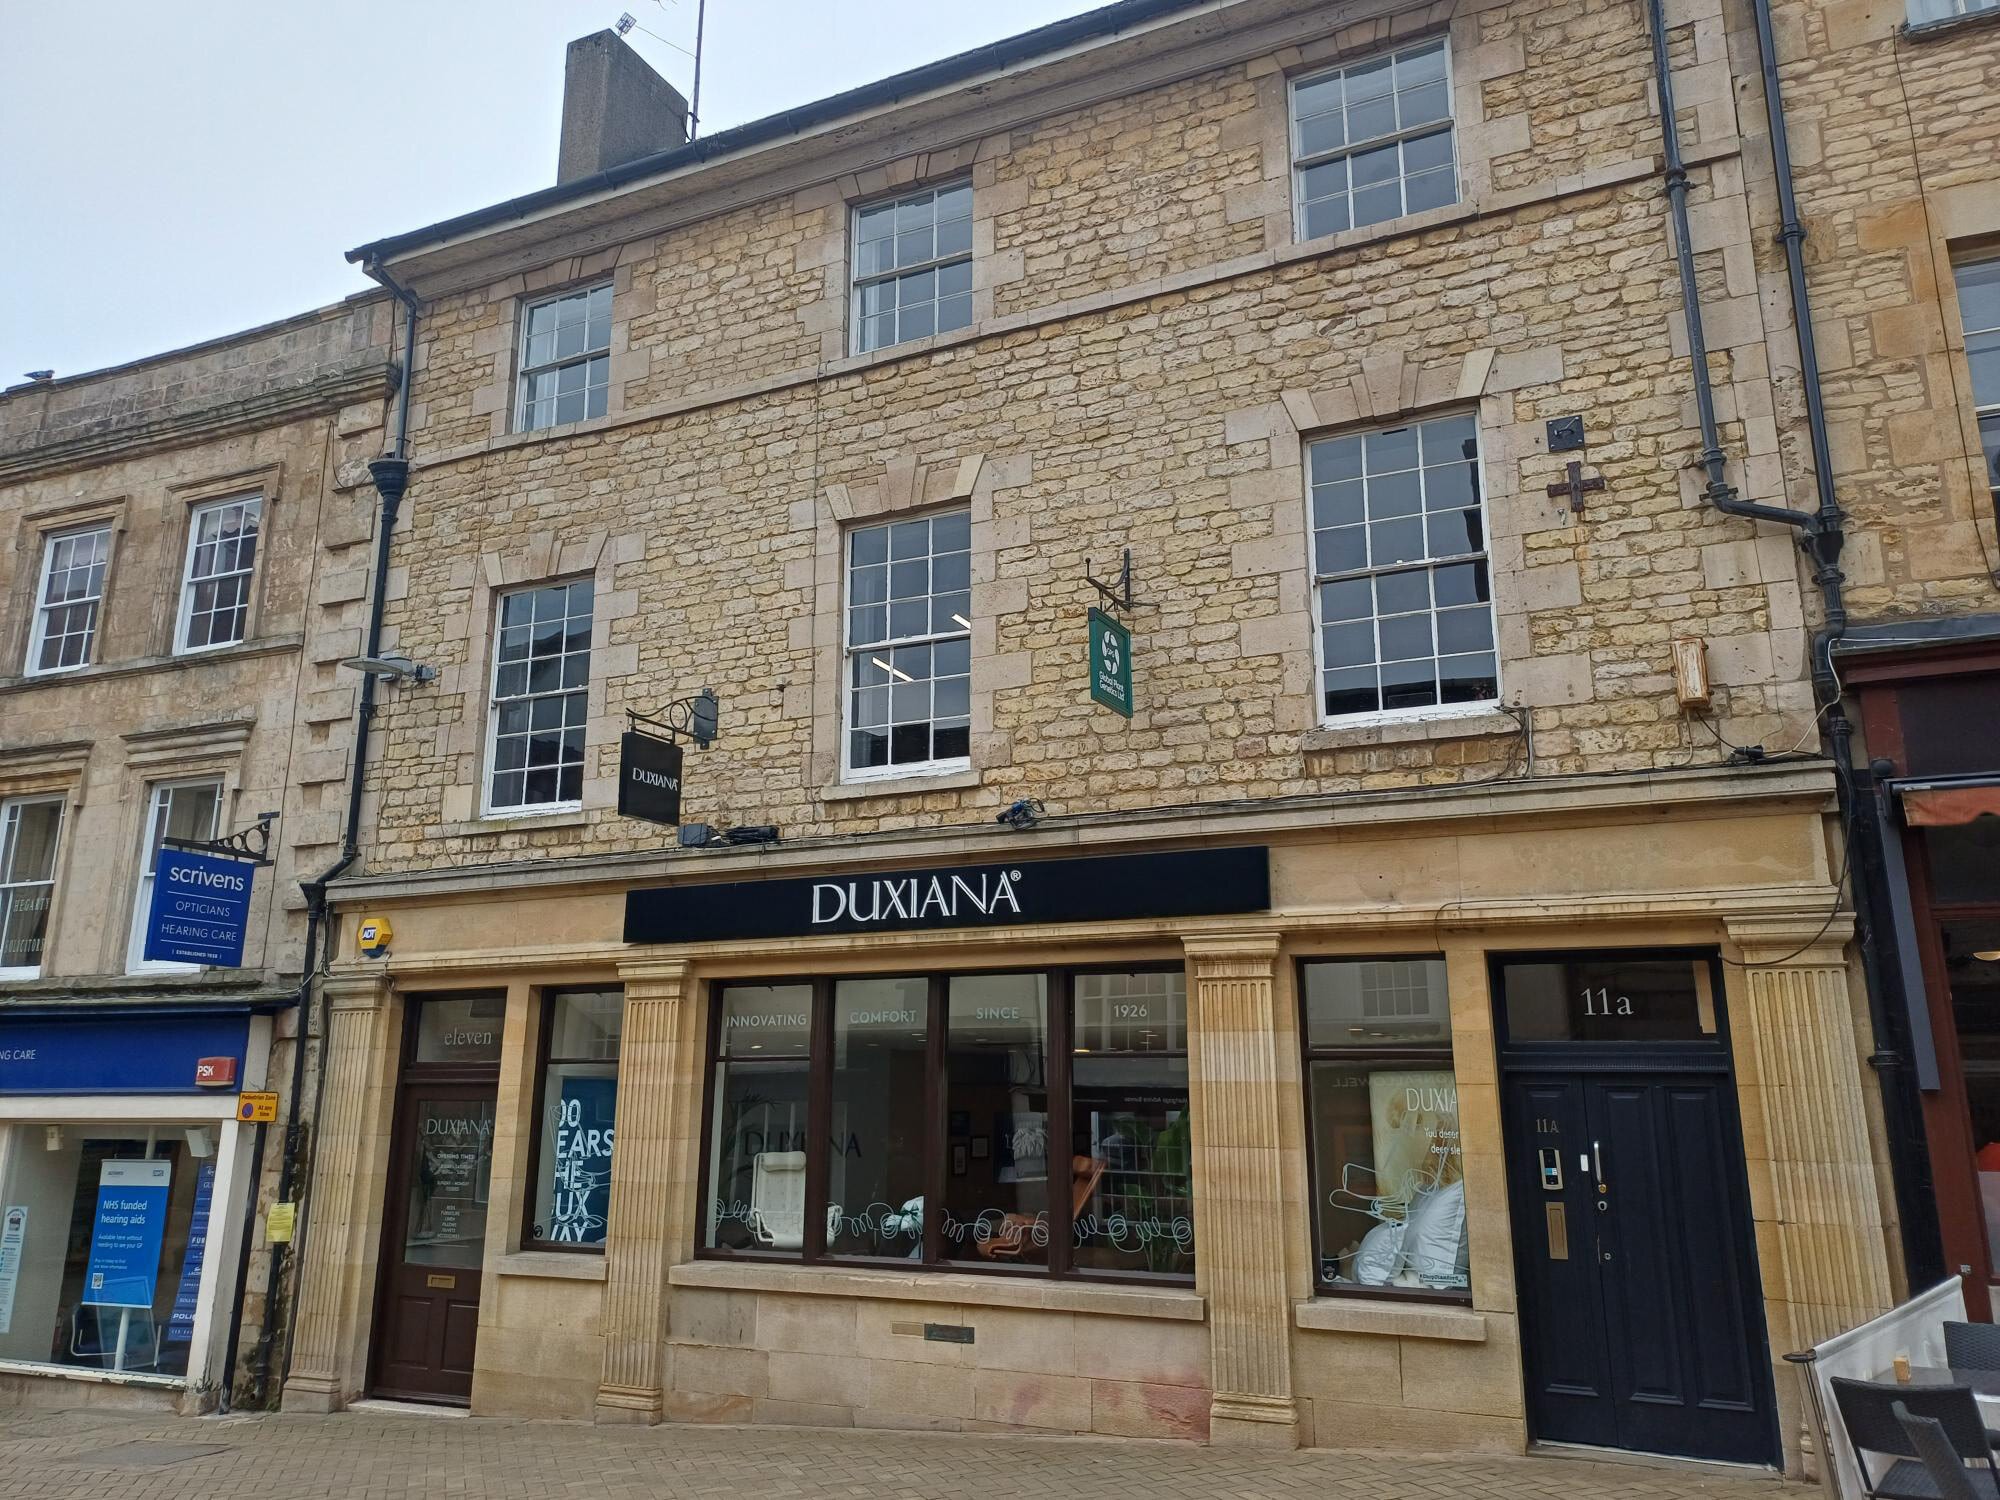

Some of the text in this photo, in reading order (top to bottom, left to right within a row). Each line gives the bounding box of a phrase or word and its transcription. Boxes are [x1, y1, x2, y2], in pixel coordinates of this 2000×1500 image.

[1099, 670, 1114, 687] Global
[1099, 679, 1118, 697] Genetics
[169, 865, 245, 891] scrivens
[175, 900, 231, 917] OPTICIANS
[161, 923, 238, 942] HEARING CARE
[1580, 987, 1634, 1016] 11a
[726, 1004, 1148, 1028] INNOVATING COMFORT SINCE 1926
[444, 1027, 492, 1046] eleven
[13, 1049, 37, 1061] CARE
[197, 1065, 214, 1077] PSK
[1424, 1127, 1438, 1138] You
[1535, 1118, 1560, 1134] 11A
[103, 1200, 148, 1211] NHS funded
[101, 1213, 146, 1226] hearing aids
